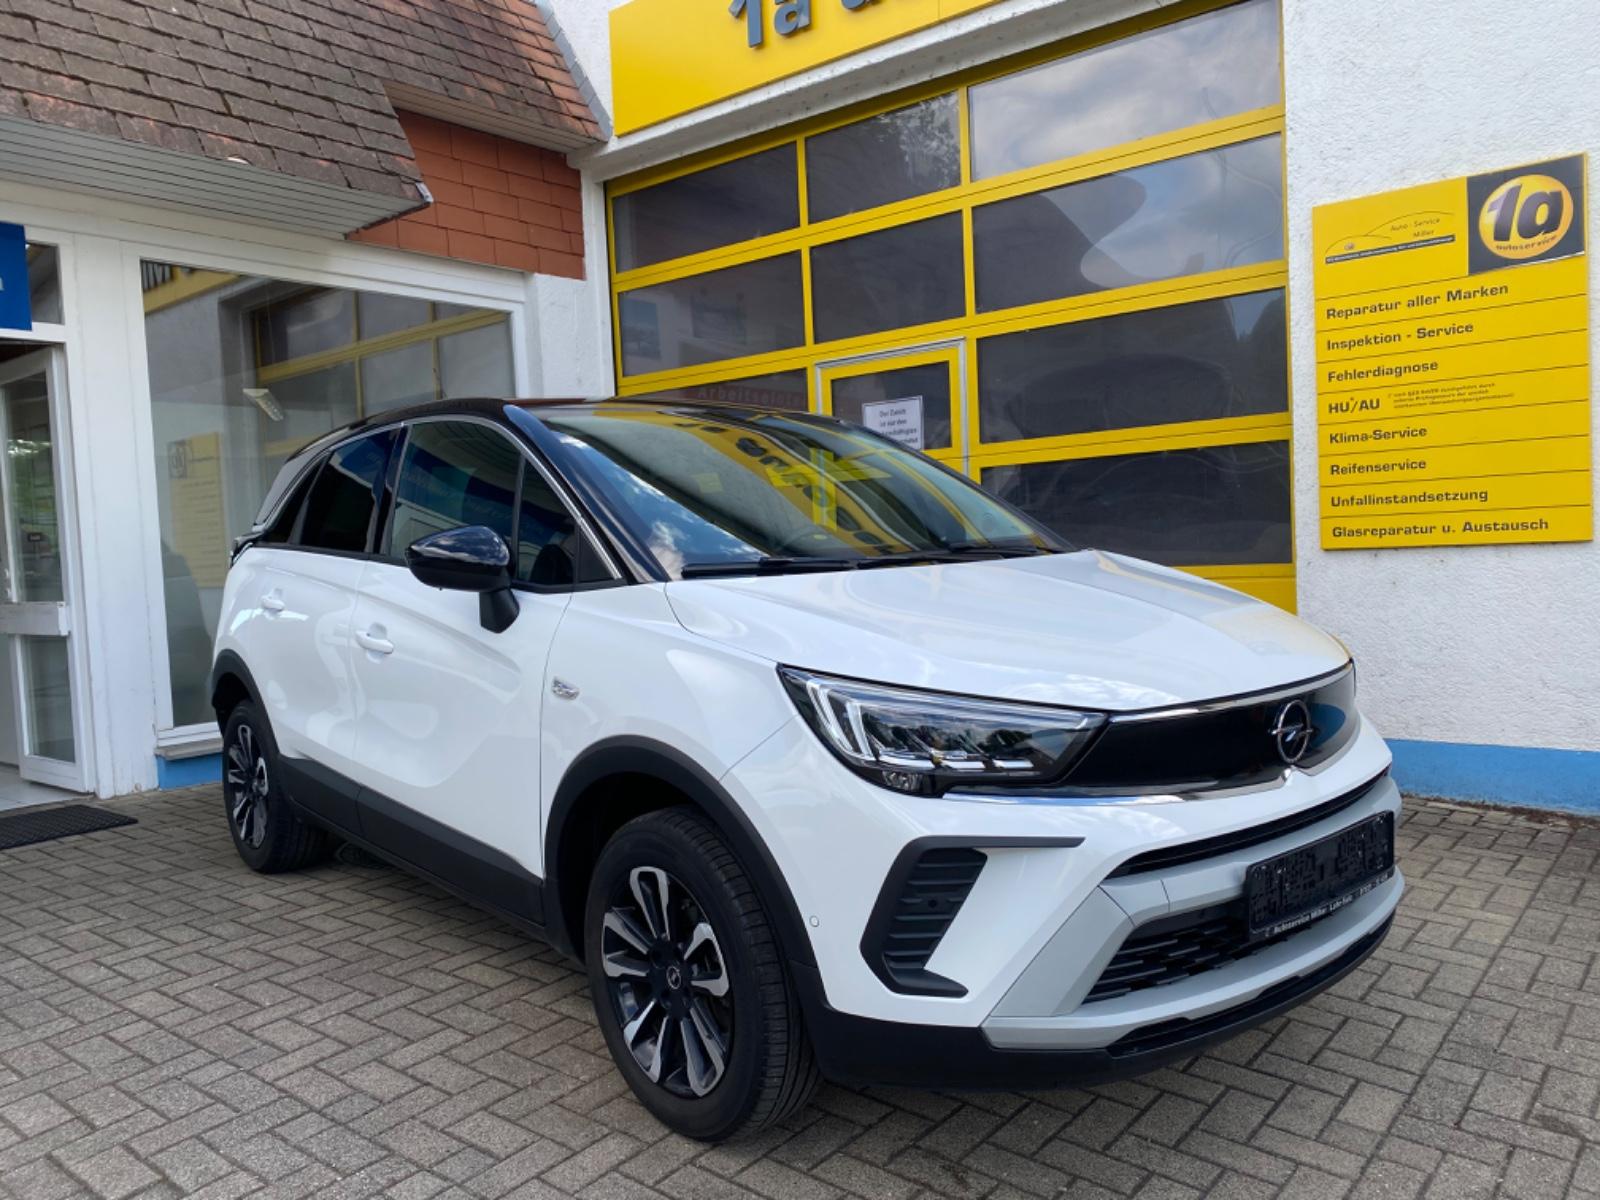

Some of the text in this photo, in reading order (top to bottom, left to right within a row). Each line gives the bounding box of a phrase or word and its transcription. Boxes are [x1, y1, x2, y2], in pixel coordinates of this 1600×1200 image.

[1487, 183, 1563, 242] 1a
[1326, 283, 1509, 320] Reparatur aller Marken
[1327, 331, 1401, 353] Inspektion
[1416, 322, 1474, 340] Service
[1327, 360, 1439, 384] Fehlerdiagnose
[1329, 426, 1428, 445] Klima-Service
[1330, 459, 1427, 476] Reifenservice
[1331, 489, 1489, 508] Unfallinstandsetzung
[1332, 518, 1549, 539] Glasreparatur u. Austausch
